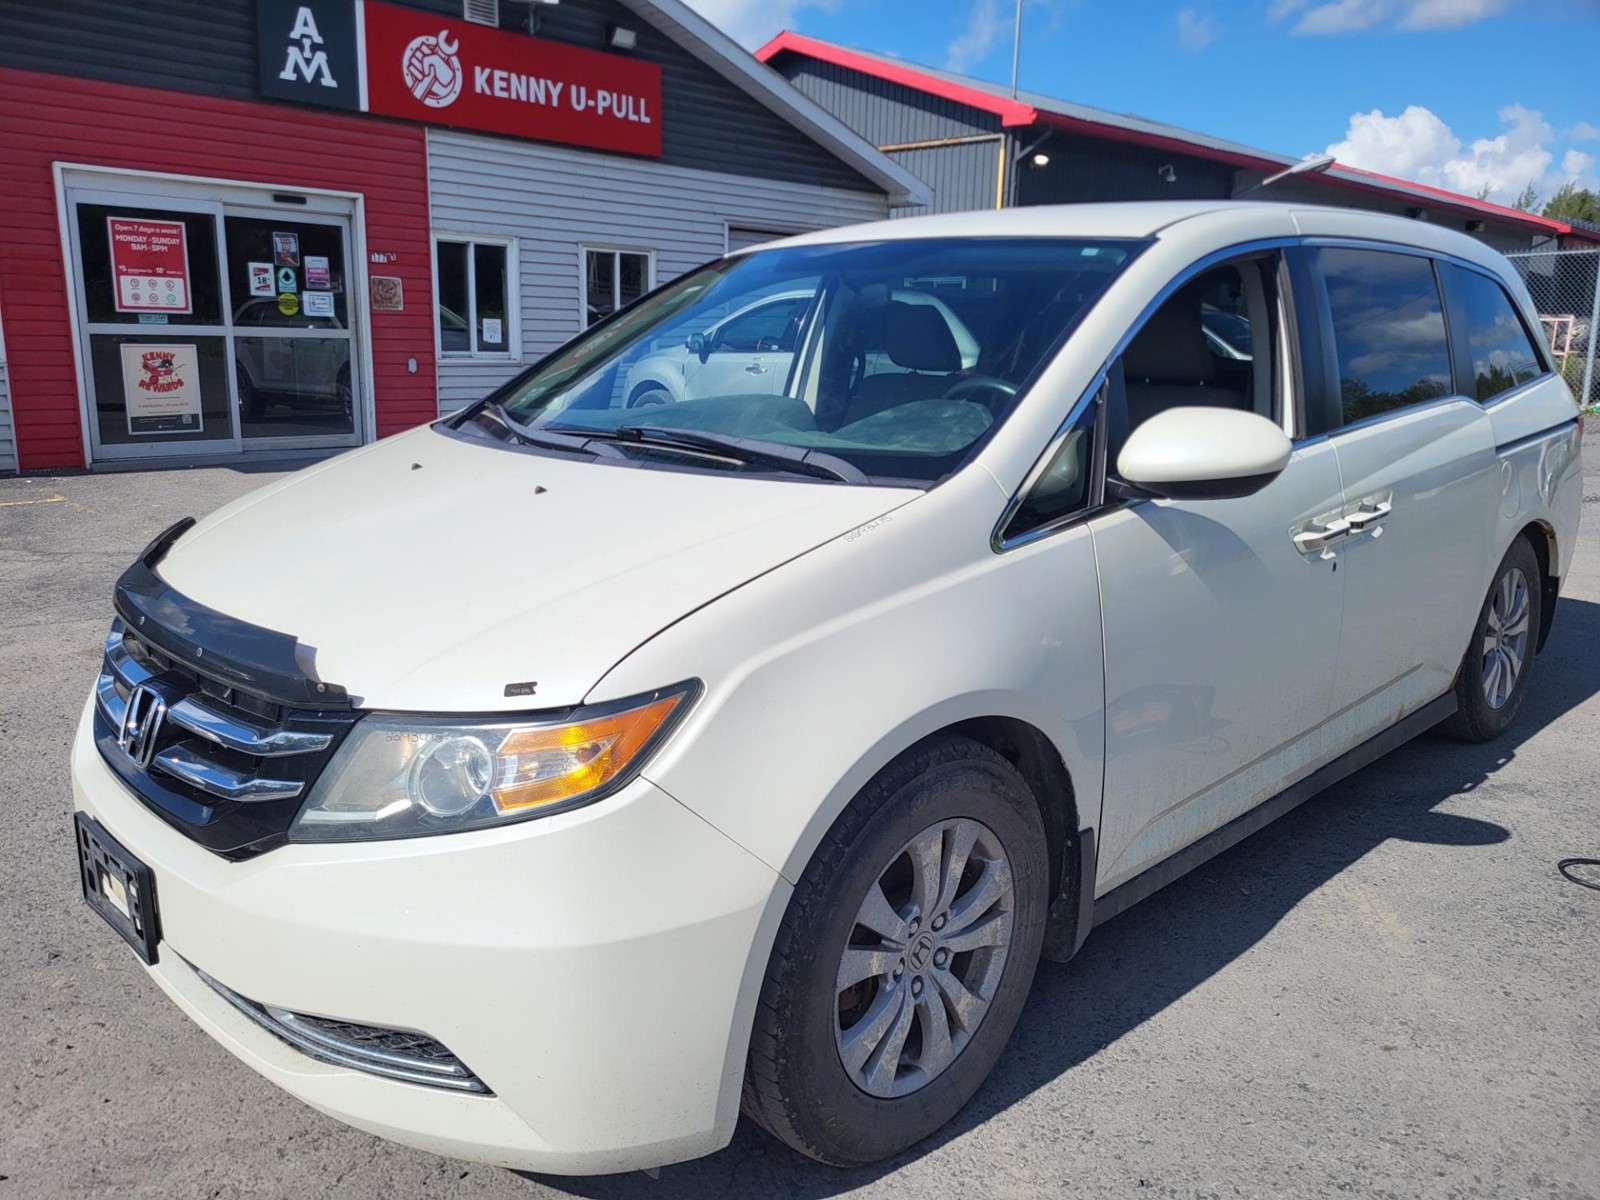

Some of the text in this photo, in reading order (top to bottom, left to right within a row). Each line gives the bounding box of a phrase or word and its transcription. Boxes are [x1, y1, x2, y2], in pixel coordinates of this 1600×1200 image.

[473, 65, 651, 123] KENNY U-PULL
[115, 224, 133, 232] Open
[138, 226, 155, 234] days
[115, 234, 147, 243] MONDAY
[151, 236, 180, 246] SUNDAY
[130, 243, 147, 251] 9AM
[142, 351, 176, 362] KENNY
[138, 378, 184, 393] REWARDS
